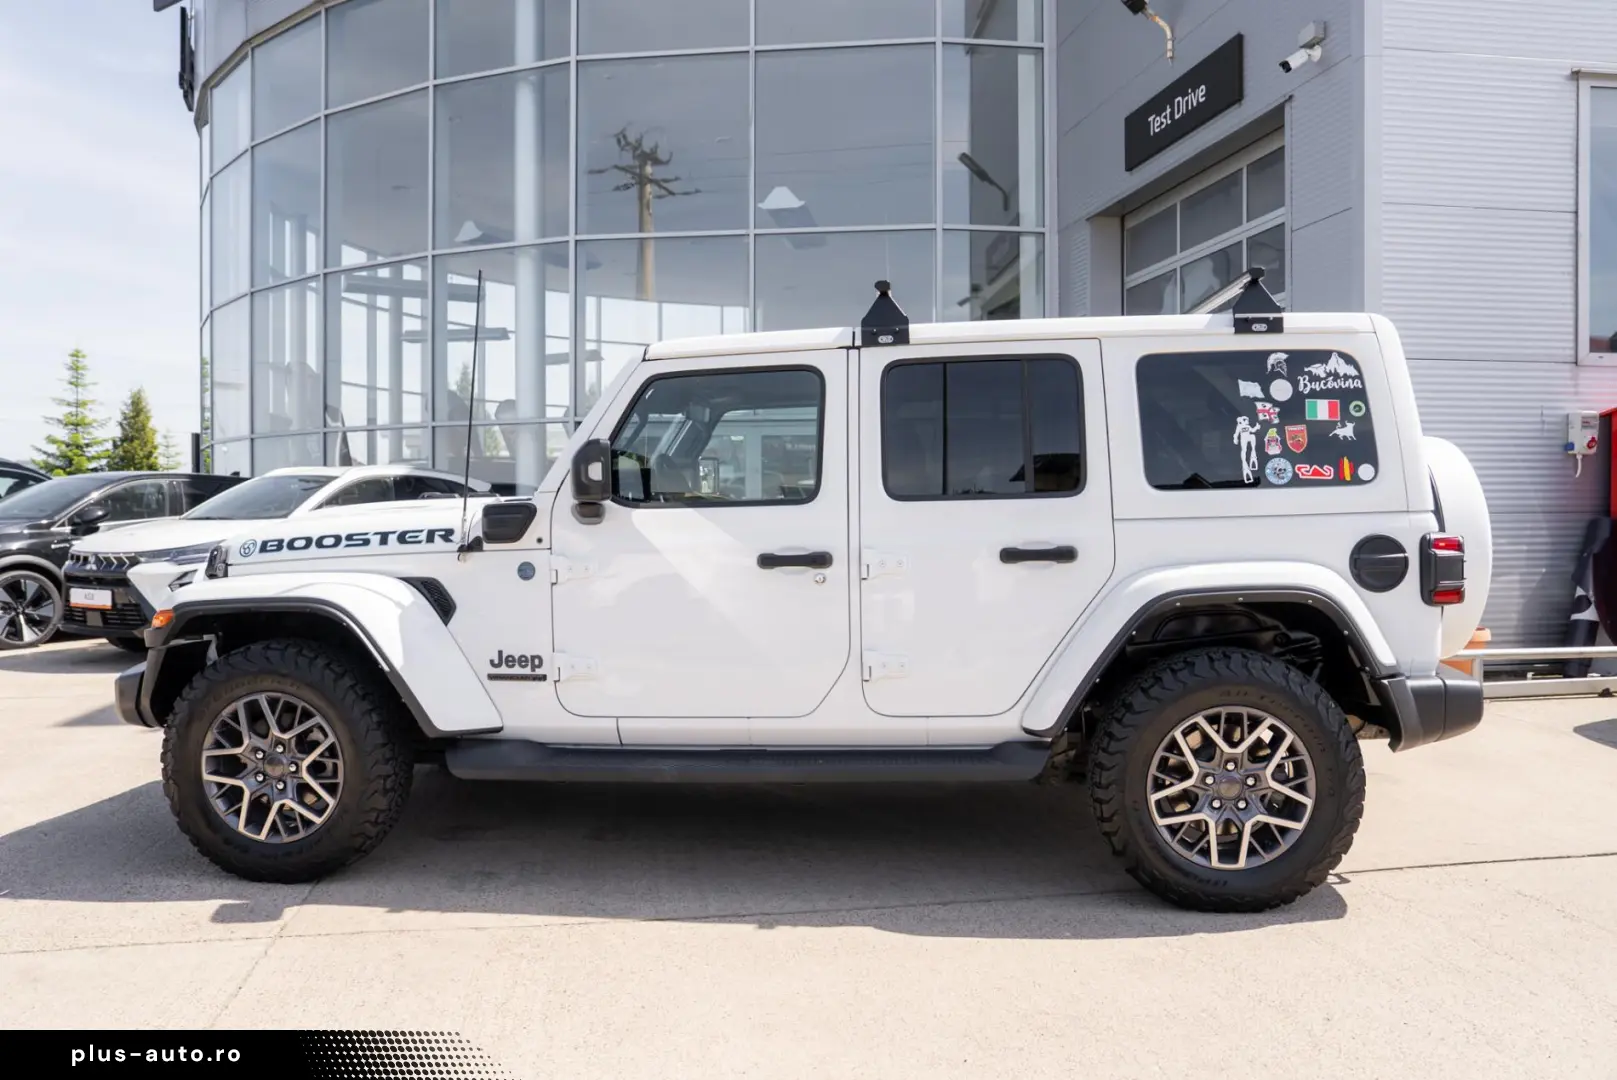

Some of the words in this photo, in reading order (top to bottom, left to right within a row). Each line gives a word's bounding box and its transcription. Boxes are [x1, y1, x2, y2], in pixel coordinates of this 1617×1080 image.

[1147, 104, 1171, 136] Test
[1174, 84, 1206, 120] Drive
[258, 528, 455, 554] BOOSTER
[489, 650, 543, 672] Jeep
